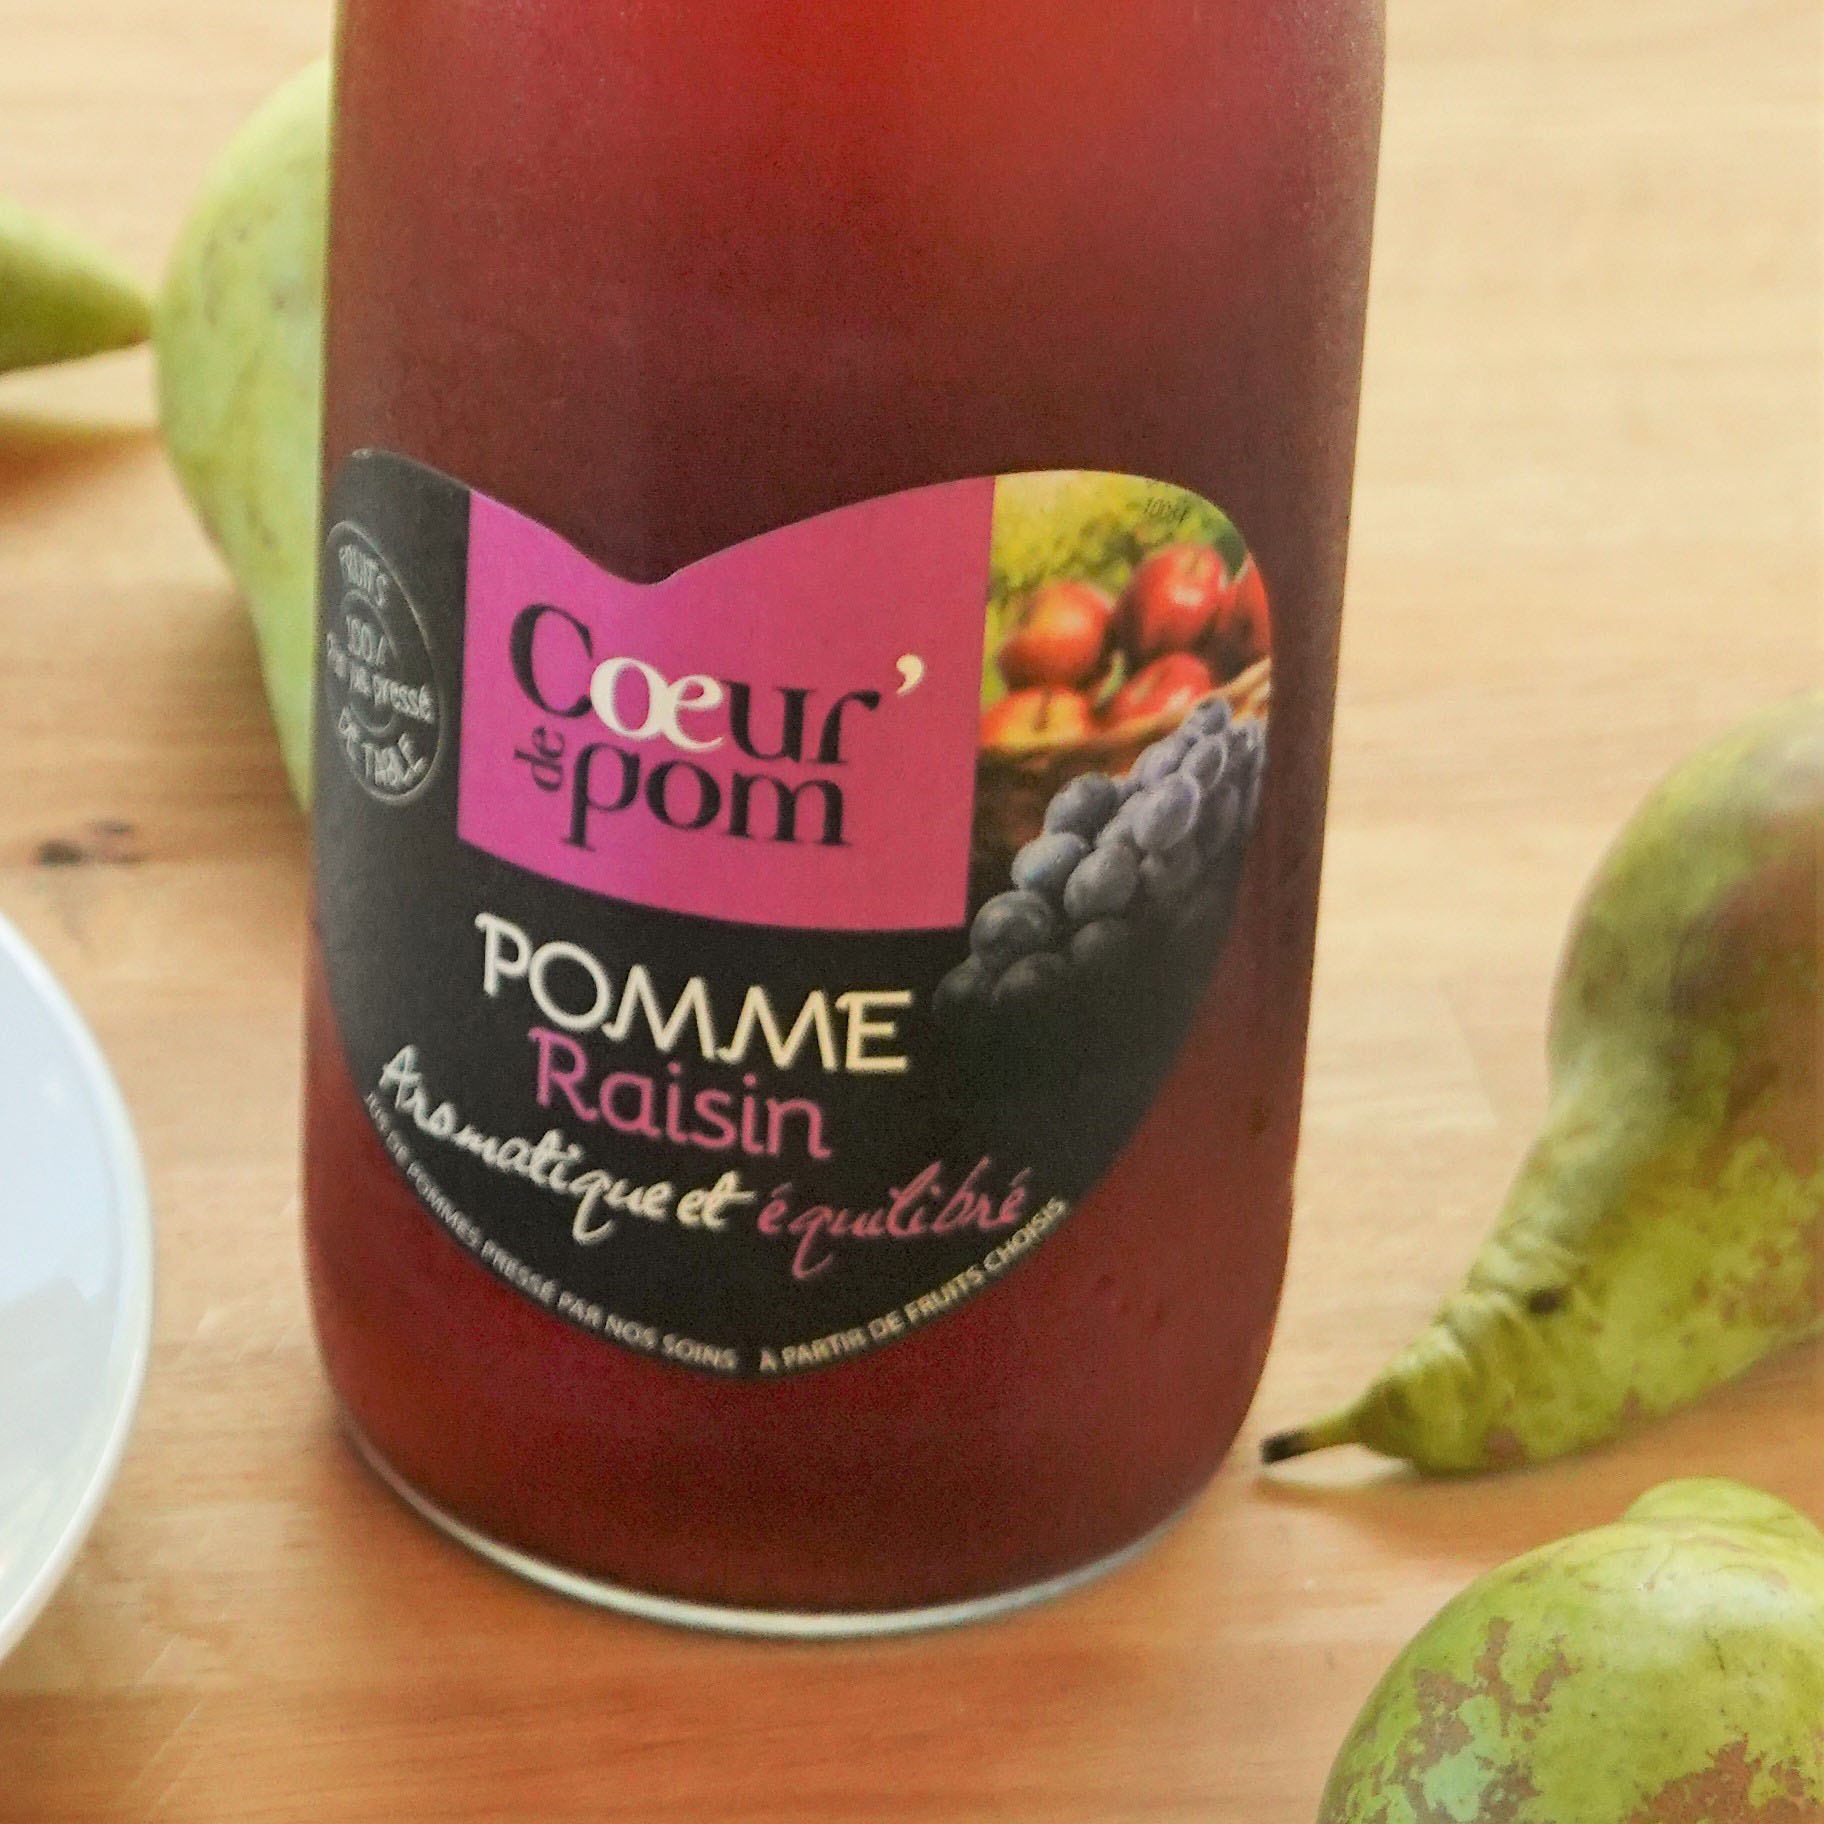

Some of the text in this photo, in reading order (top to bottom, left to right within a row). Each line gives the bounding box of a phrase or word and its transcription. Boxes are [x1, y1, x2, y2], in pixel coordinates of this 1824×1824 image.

[514, 724, 565, 793] de
[562, 741, 851, 853] pom
[474, 911, 914, 1075] POMME
[378, 1043, 1031, 1281] Aromatique et équilibré
[527, 1026, 834, 1161] Raisin
[406, 1161, 484, 1249] POMMES
[557, 1290, 605, 1330] PAR
[604, 1312, 659, 1351] NOS
[662, 1332, 740, 1372] SOINS
[781, 1327, 868, 1369] PARTIR
[867, 1309, 906, 1341] DE
[903, 1264, 985, 1326] FRUITS
[983, 1195, 1067, 1272] CHOISIS
